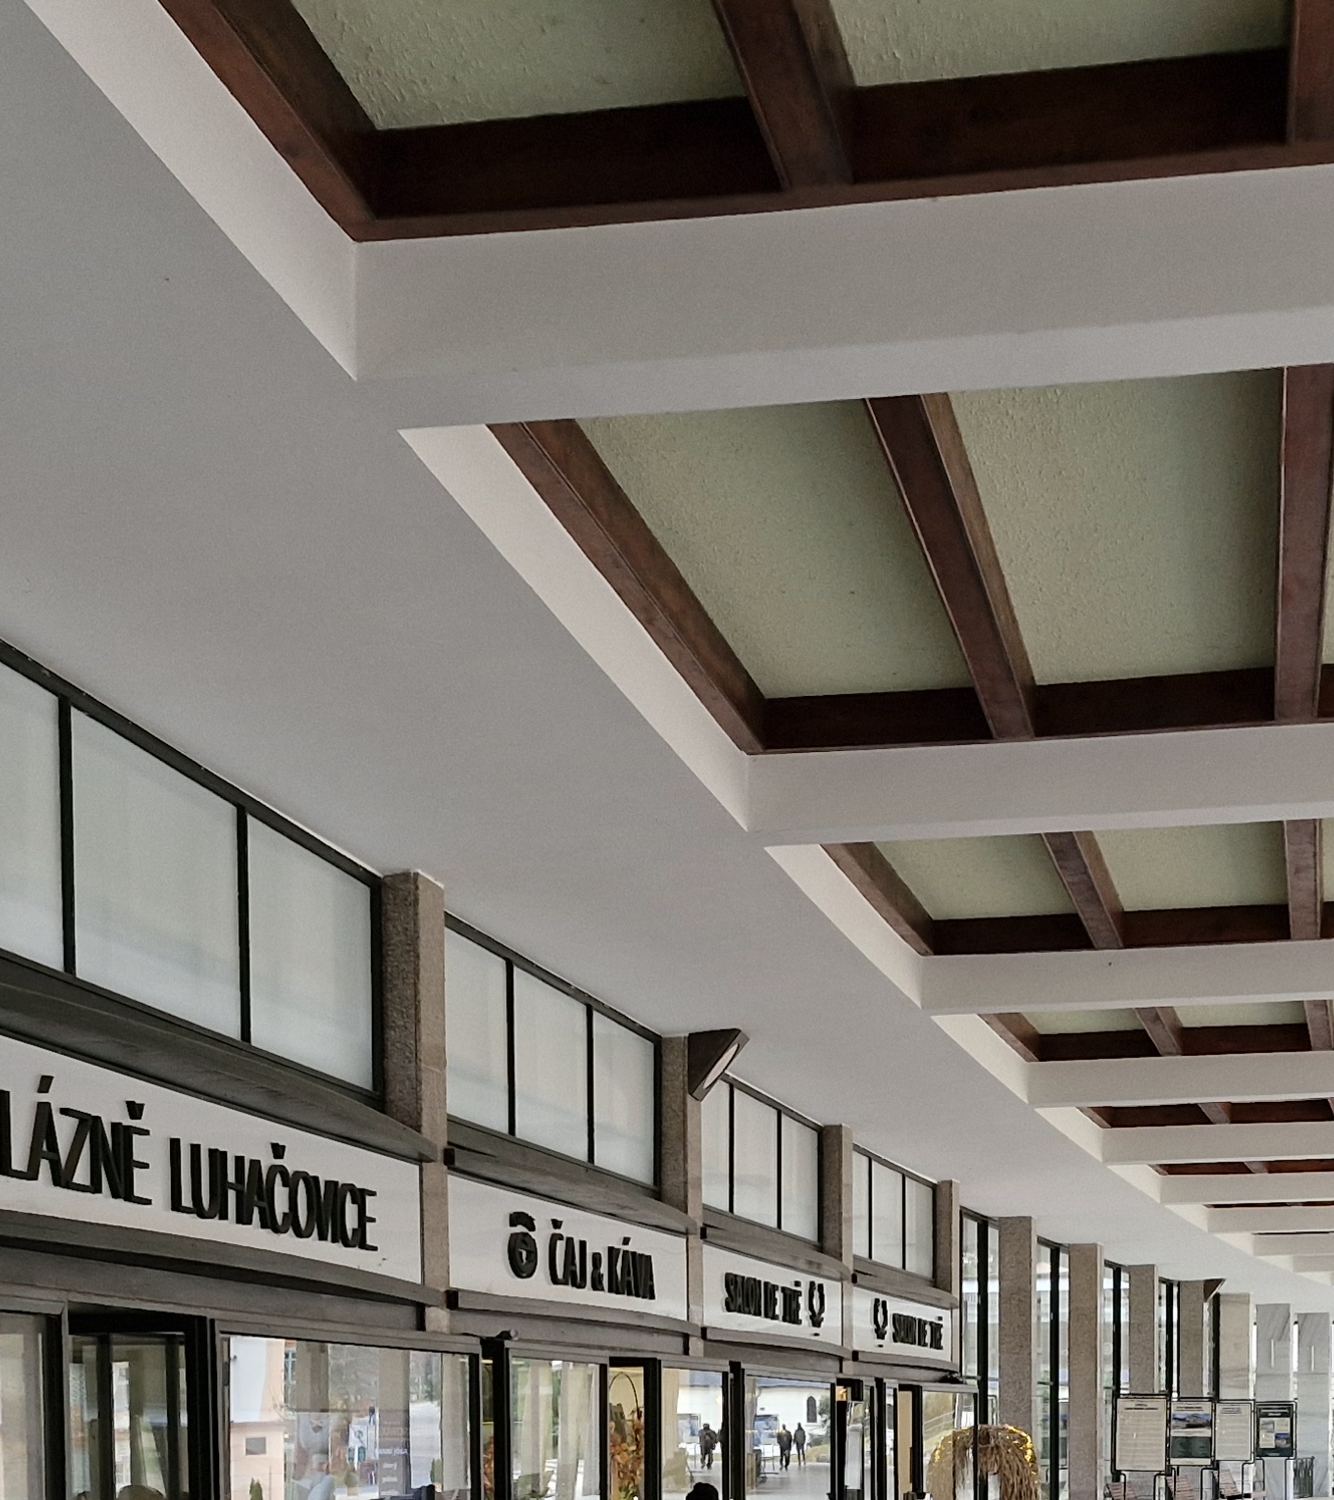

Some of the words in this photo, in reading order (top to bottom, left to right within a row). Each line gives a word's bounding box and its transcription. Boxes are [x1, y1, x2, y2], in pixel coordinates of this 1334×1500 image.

[169, 1141, 379, 1251] LUHAČOVICE
[548, 1218, 587, 1289] ČAJ
[590, 1252, 605, 1292] &
[607, 1236, 656, 1300] KÁVA
[724, 1272, 762, 1317] SALON
[763, 1280, 780, 1321] DE
